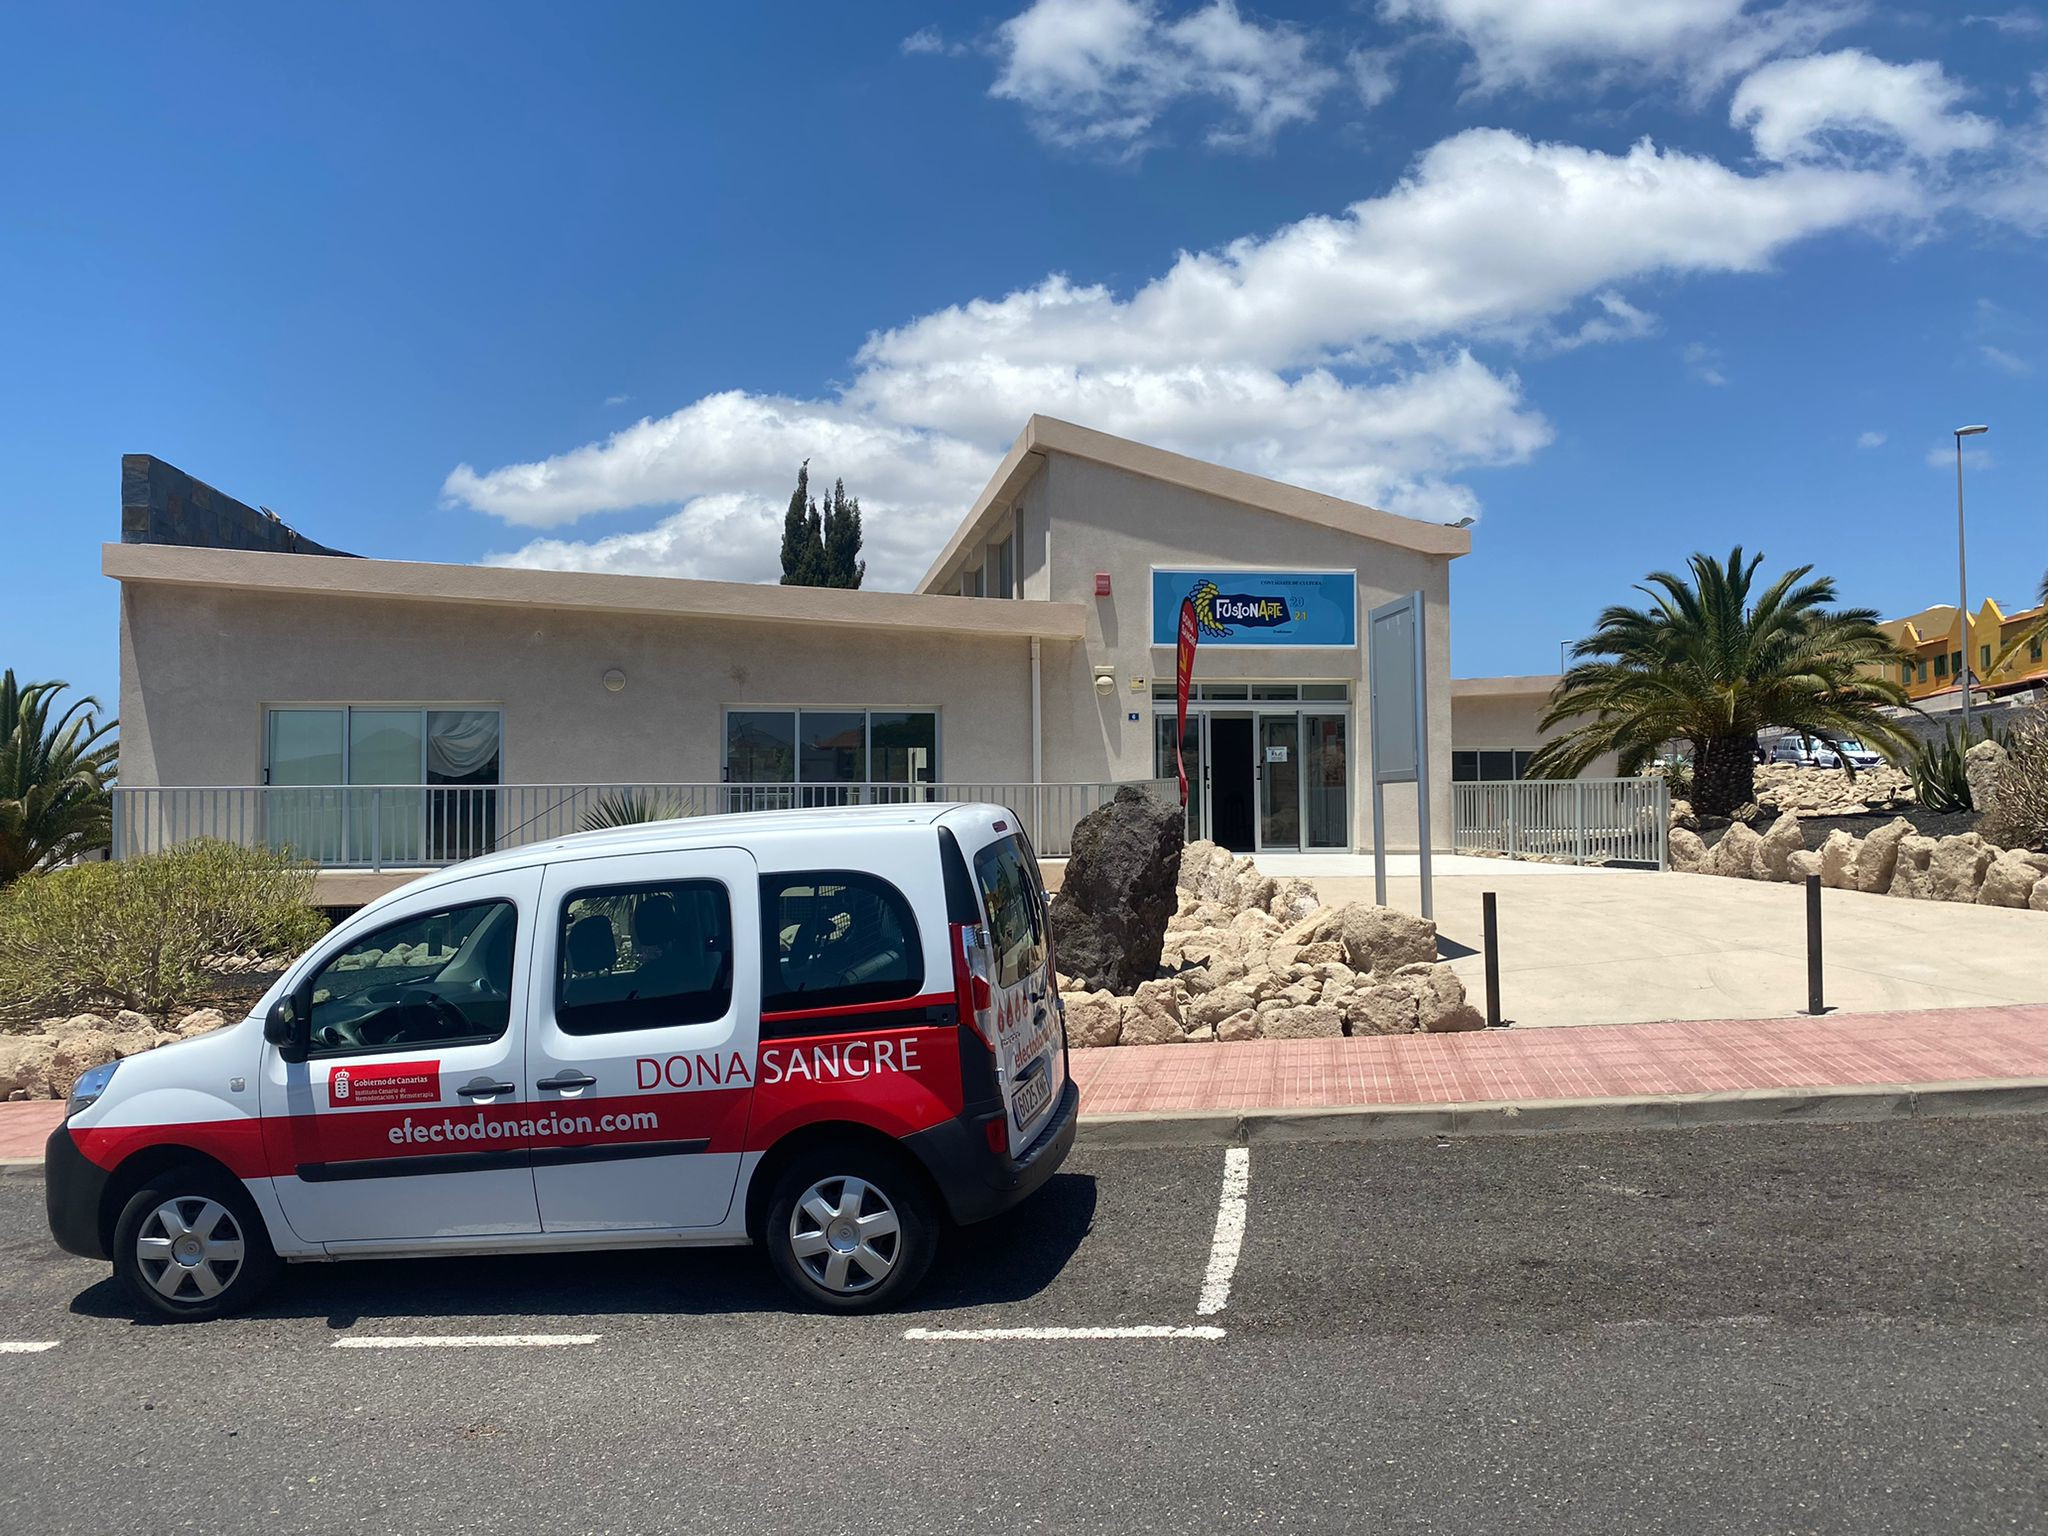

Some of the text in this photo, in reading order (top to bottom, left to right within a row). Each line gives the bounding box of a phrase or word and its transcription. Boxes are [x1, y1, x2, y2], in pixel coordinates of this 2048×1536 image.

[636, 1037, 921, 1090] DONA SANGRE
[353, 1076, 428, 1087] Gobierno de Canarias
[1018, 1084, 1039, 1118] 6025
[388, 1110, 659, 1145] efectodonacion.com
